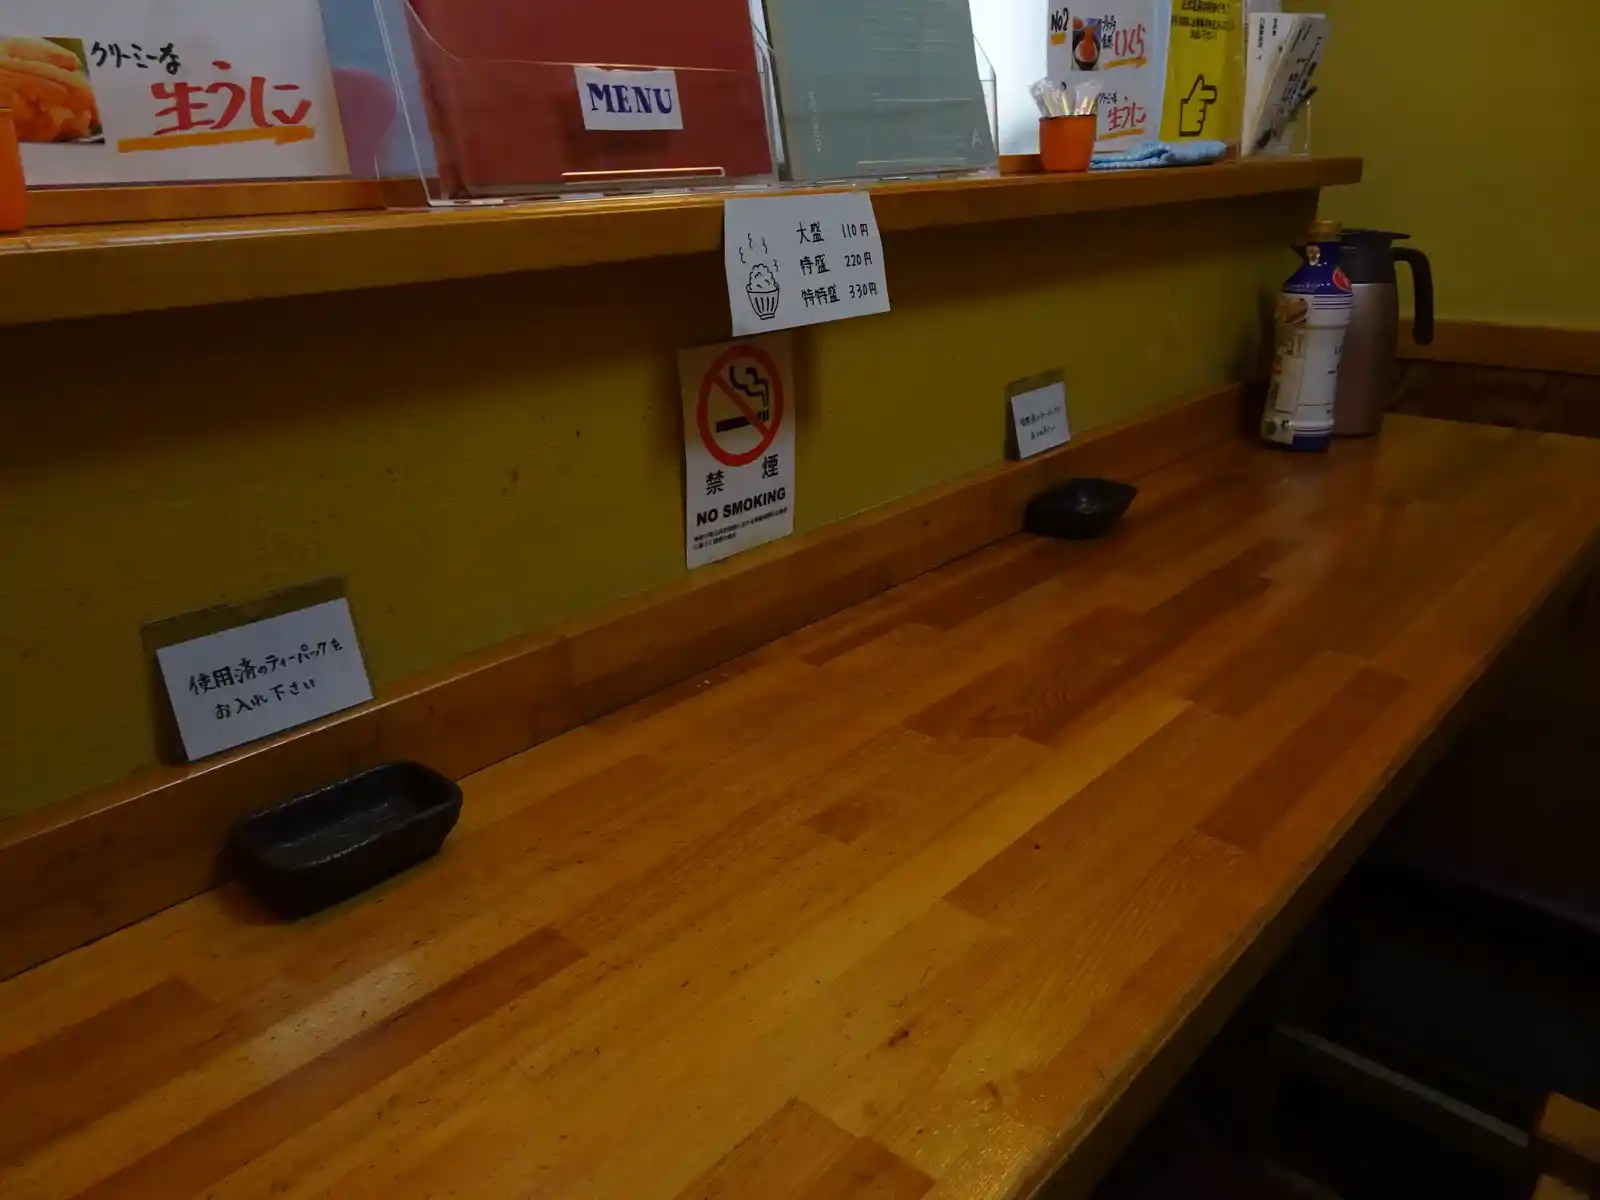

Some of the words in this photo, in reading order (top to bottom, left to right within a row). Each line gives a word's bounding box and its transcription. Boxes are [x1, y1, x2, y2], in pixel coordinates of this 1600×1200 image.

[91, 41, 182, 75] クリーミーな
[151, 60, 312, 136] 生うに
[586, 82, 672, 114] MENU
[1107, 95, 1147, 131] 生うに
[796, 221, 825, 244] 大盛
[841, 223, 869, 238] 110円
[799, 253, 830, 276] 特盛
[844, 251, 873, 268] 220円
[801, 283, 841, 307] 特特盛
[849, 282, 878, 299] 330円
[696, 508, 718, 526] NO
[722, 486, 786, 518] SMOKING
[215, 678, 316, 720] お入れ下さい
